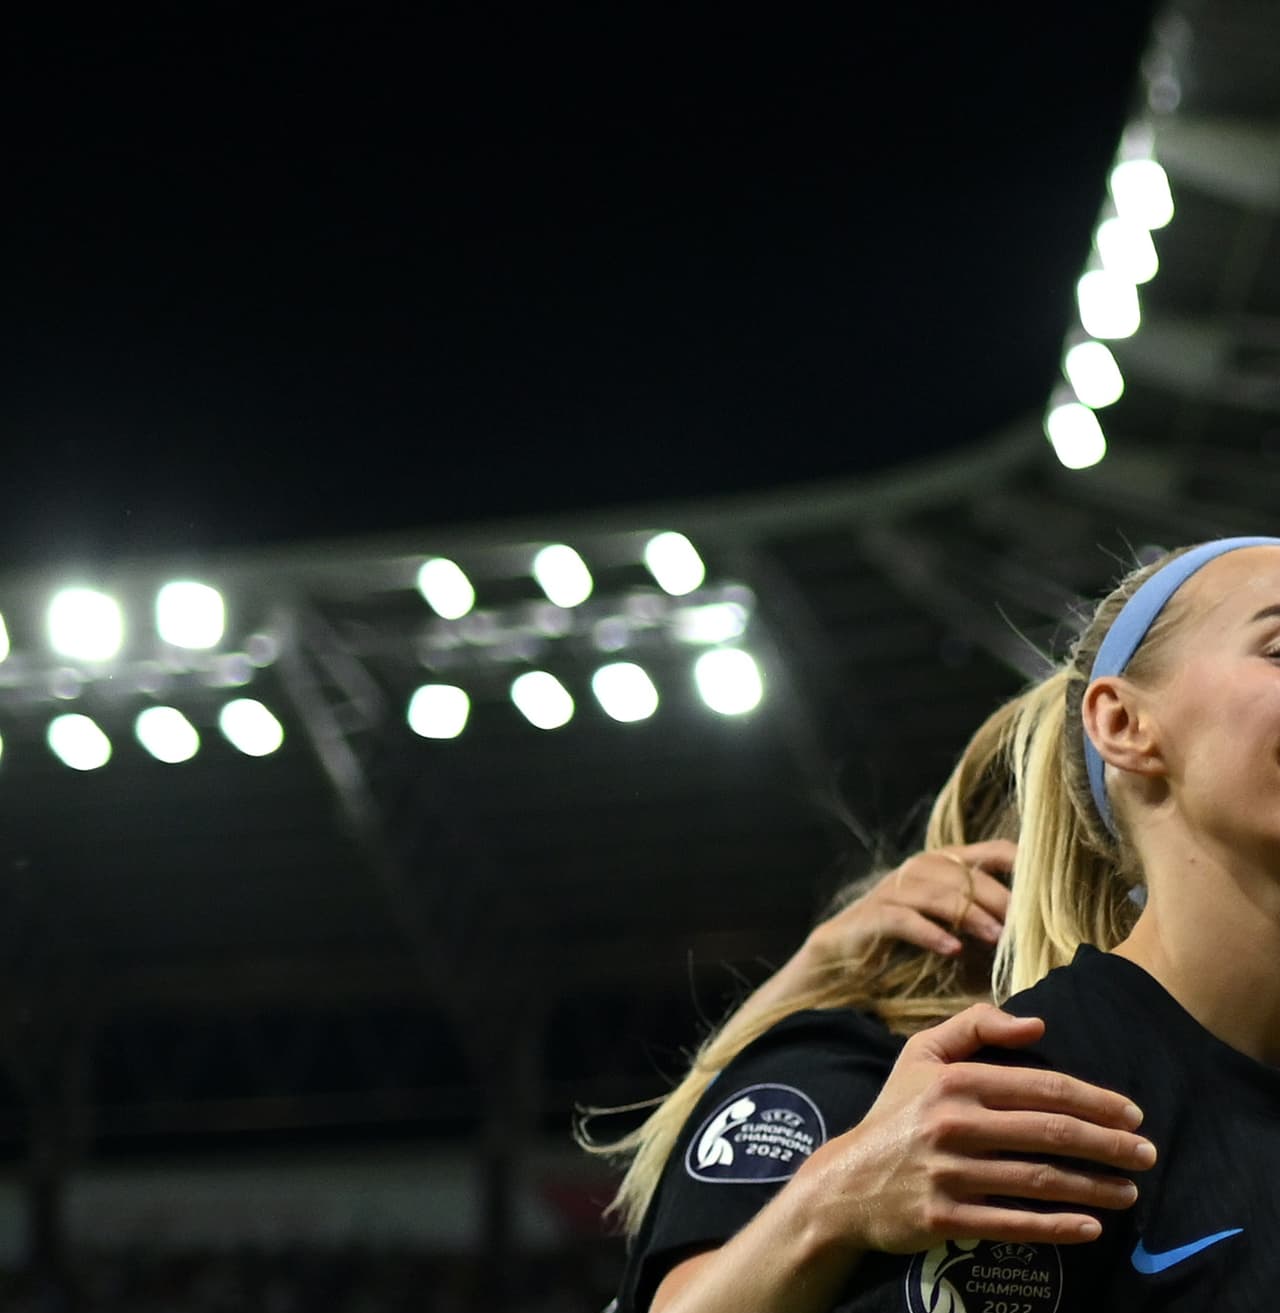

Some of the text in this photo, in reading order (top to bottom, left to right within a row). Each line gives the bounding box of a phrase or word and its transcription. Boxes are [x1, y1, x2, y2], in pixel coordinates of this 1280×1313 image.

[740, 1123, 814, 1145] EUROPEAN
[734, 1132, 812, 1156] CHAMPIONS
[745, 1143, 793, 1162] 2022
[992, 1244, 1034, 1264] UEFA
[971, 1265, 1050, 1283] EUROPEAN
[965, 1280, 1052, 1299] CHAMPIONS
